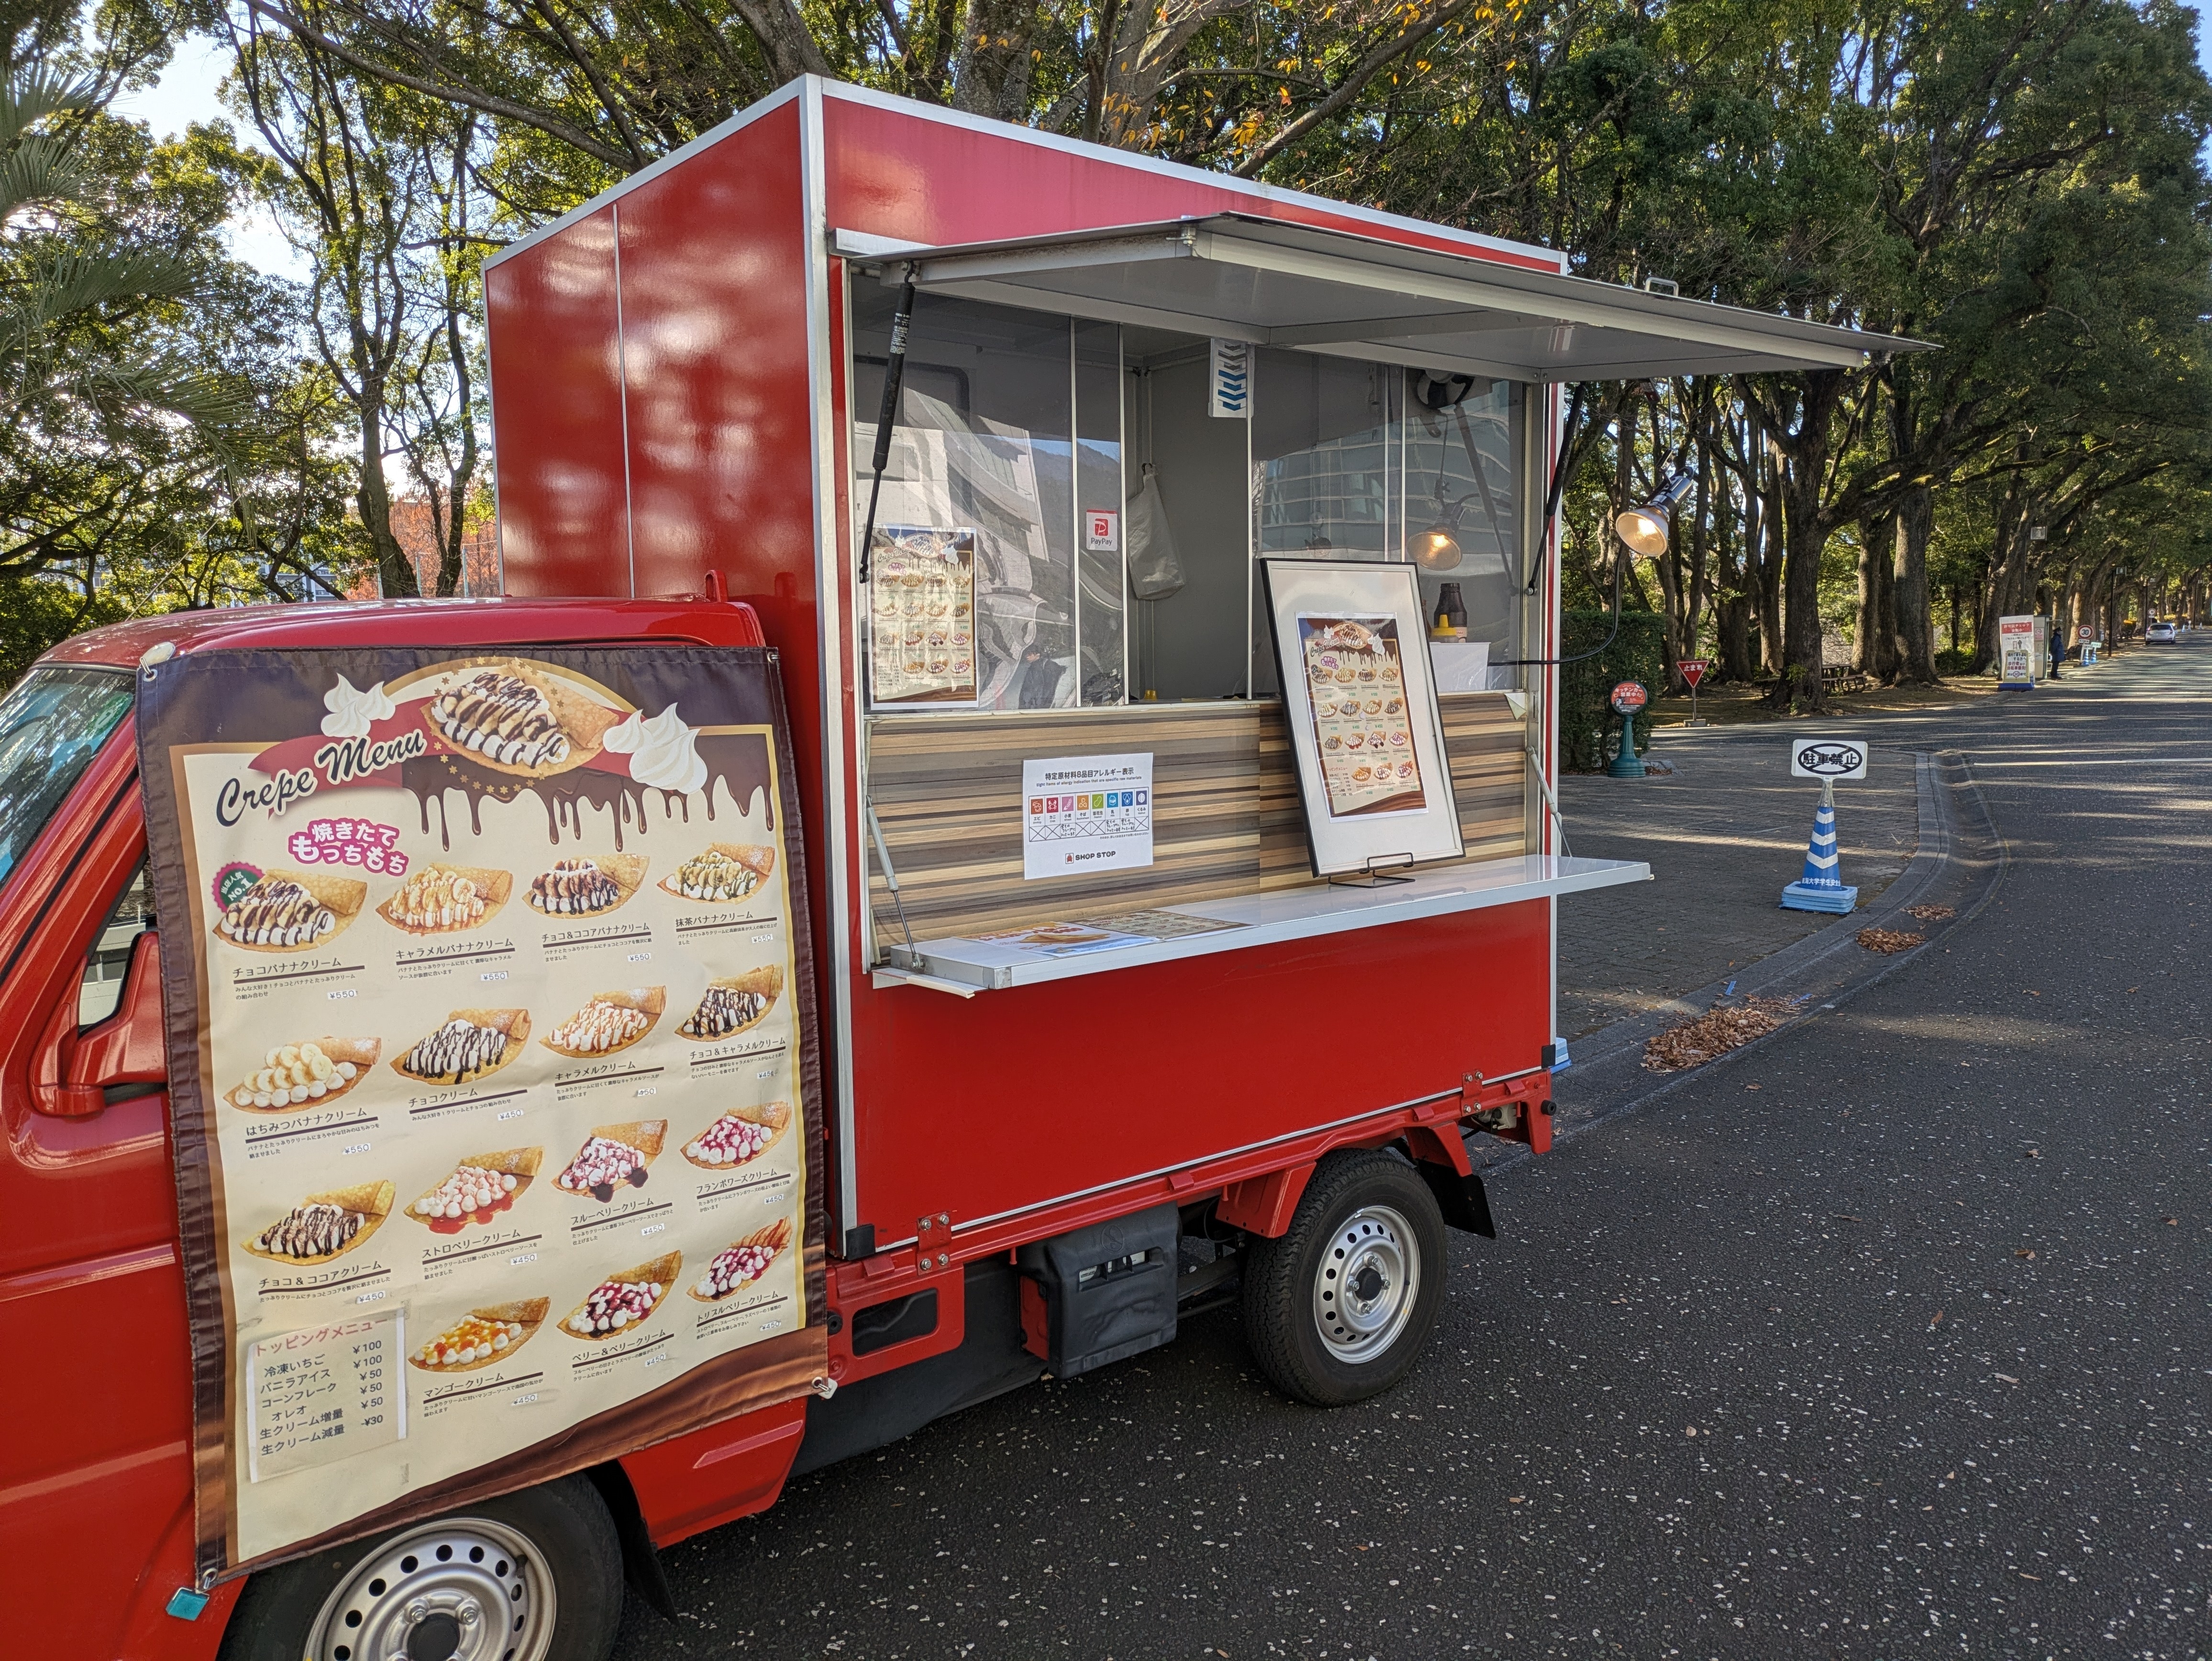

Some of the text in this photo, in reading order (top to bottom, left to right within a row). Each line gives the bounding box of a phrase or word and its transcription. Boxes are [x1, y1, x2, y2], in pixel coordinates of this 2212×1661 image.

[1091, 537, 1112, 546] PayPay
[1311, 638, 1339, 657] Crepe Menu
[1803, 753, 1858, 765] 駐車禁止
[216, 732, 426, 827] Crepe Menu
[1045, 767, 1134, 780] 特定原材料8品目アレルギー表示
[312, 821, 397, 846] 焼きたて
[292, 836, 406, 874] もっちもち
[221, 872, 243, 895] 当店人気
[228, 878, 253, 901] NO.1
[675, 911, 753, 927] 抹茶バナナクリーム
[753, 935, 772, 943] ¥550
[396, 939, 513, 959] キャラメルバナナクリーム
[232, 958, 341, 978] チョコバナナクリーム
[236, 992, 268, 1000] の組み合わせ
[330, 990, 355, 999] ¥550
[555, 1062, 636, 1080] キャラメルクリーム
[409, 1088, 478, 1107] チョコクリーム
[246, 1108, 367, 1136] はちみつバナナクリーム
[500, 1110, 521, 1119] ¥450
[344, 1144, 369, 1154] ¥550
[697, 1169, 777, 1194] フランボワーズクリーム
[766, 1195, 783, 1204] ¥450
[571, 1198, 654, 1225] ブルーベリークリーム
[643, 1225, 663, 1234] ¥450
[422, 1229, 520, 1258] ストロベリークリーム
[573, 1236, 598, 1245] 仕上げました
[513, 1254, 535, 1264] ¥450
[360, 1292, 384, 1302] ¥450
[697, 1291, 778, 1323] トリプルベリークリーム
[762, 1321, 780, 1330] ¥450
[256, 1319, 387, 1357] トッピングメニュー
[265, 1340, 382, 1378] 冷凍いちご ¥100
[646, 1354, 664, 1366] ¥450
[260, 1355, 382, 1394] バニラアイス ¥100
[262, 1369, 382, 1408] コーンフレーク ¥50
[424, 1373, 504, 1397] マンゴークリーム
[272, 1382, 382, 1421] オレオ ¥50
[513, 1395, 536, 1405] ¥450
[260, 1397, 383, 1440] 生クリーム増量 ¥50
[262, 1415, 383, 1456] 生クリーム減量 -¥30
